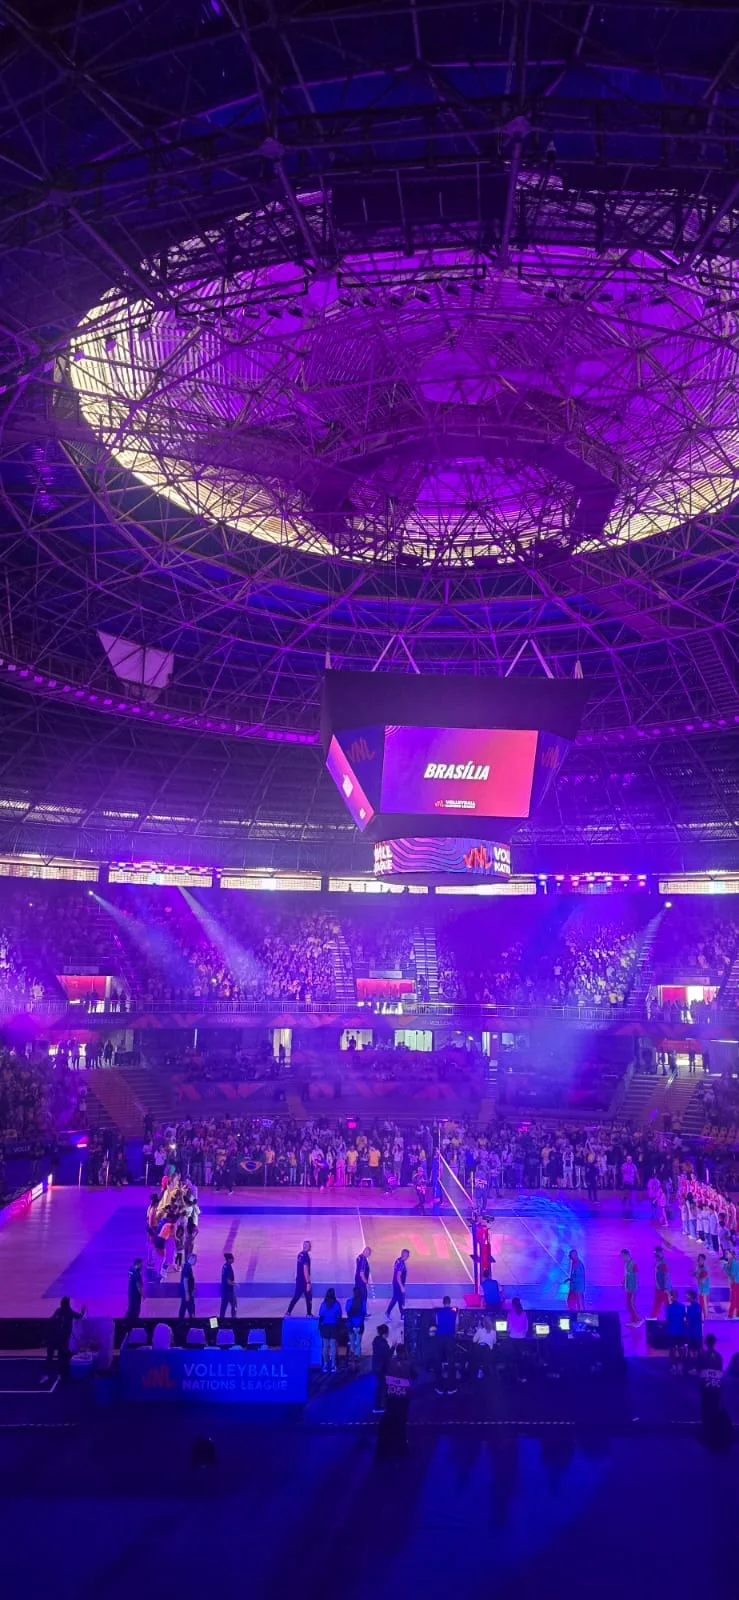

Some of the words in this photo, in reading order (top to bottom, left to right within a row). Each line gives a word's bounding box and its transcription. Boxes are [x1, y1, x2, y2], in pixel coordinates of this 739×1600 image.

[424, 760, 490, 781] BRASÍLIA
[464, 845, 493, 869] VNL
[142, 1362, 175, 1388] VNL
[184, 1363, 288, 1378] VOLLEYBALL
[182, 1379, 236, 1391] NATIONS
[241, 1379, 288, 1391] LEAGUE
